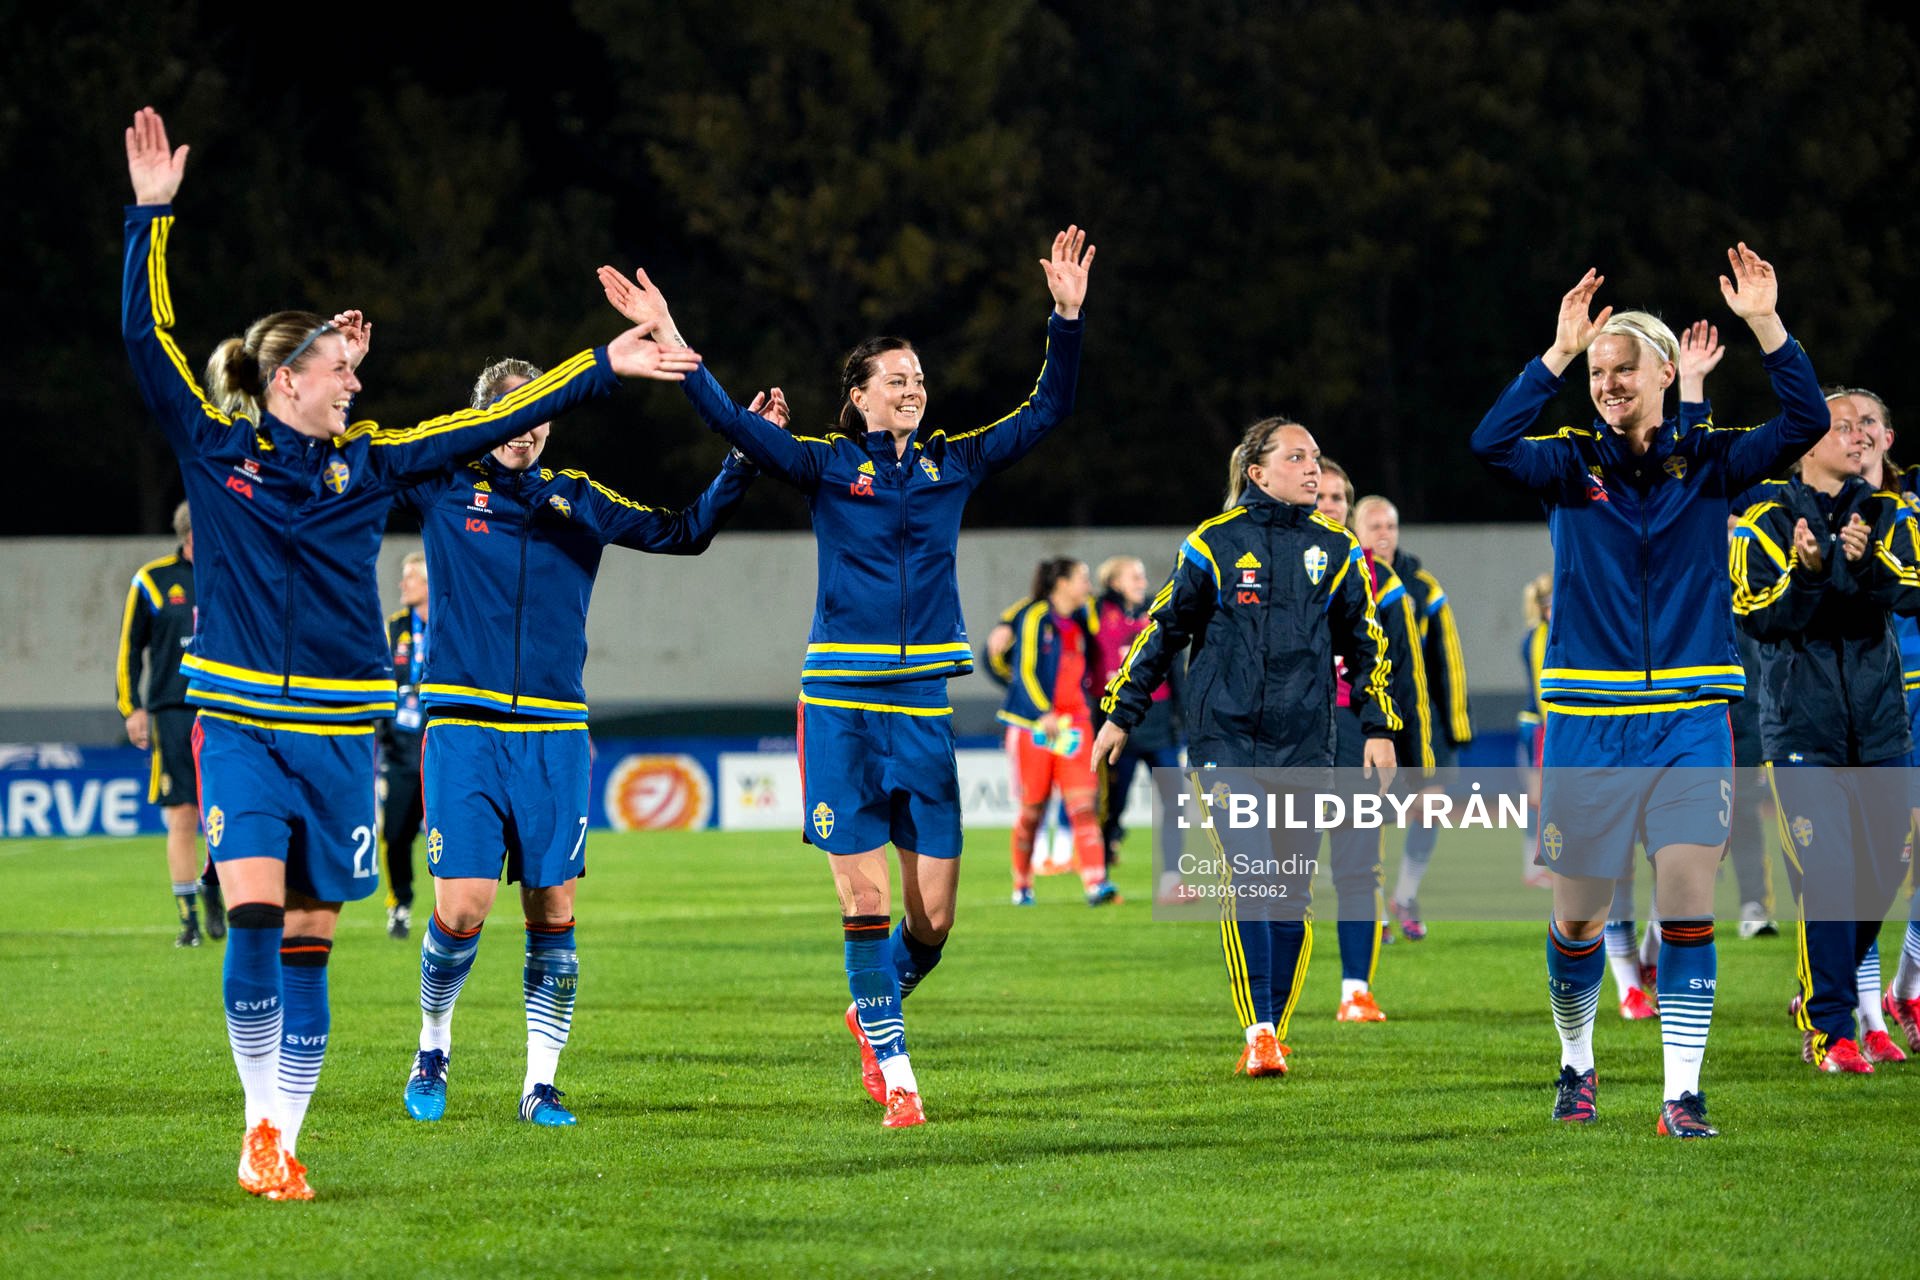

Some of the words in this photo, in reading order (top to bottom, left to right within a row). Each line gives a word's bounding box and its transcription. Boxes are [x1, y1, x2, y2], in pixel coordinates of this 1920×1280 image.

[226, 476, 253, 499] ICA
[850, 482, 875, 497] ICA
[465, 517, 490, 534] ICA
[1237, 591, 1260, 605] ICA
[0, 778, 141, 836] RVE
[234, 996, 278, 1011] SVFF
[857, 996, 893, 1009] SVFF
[285, 1034, 328, 1046] SVFF
